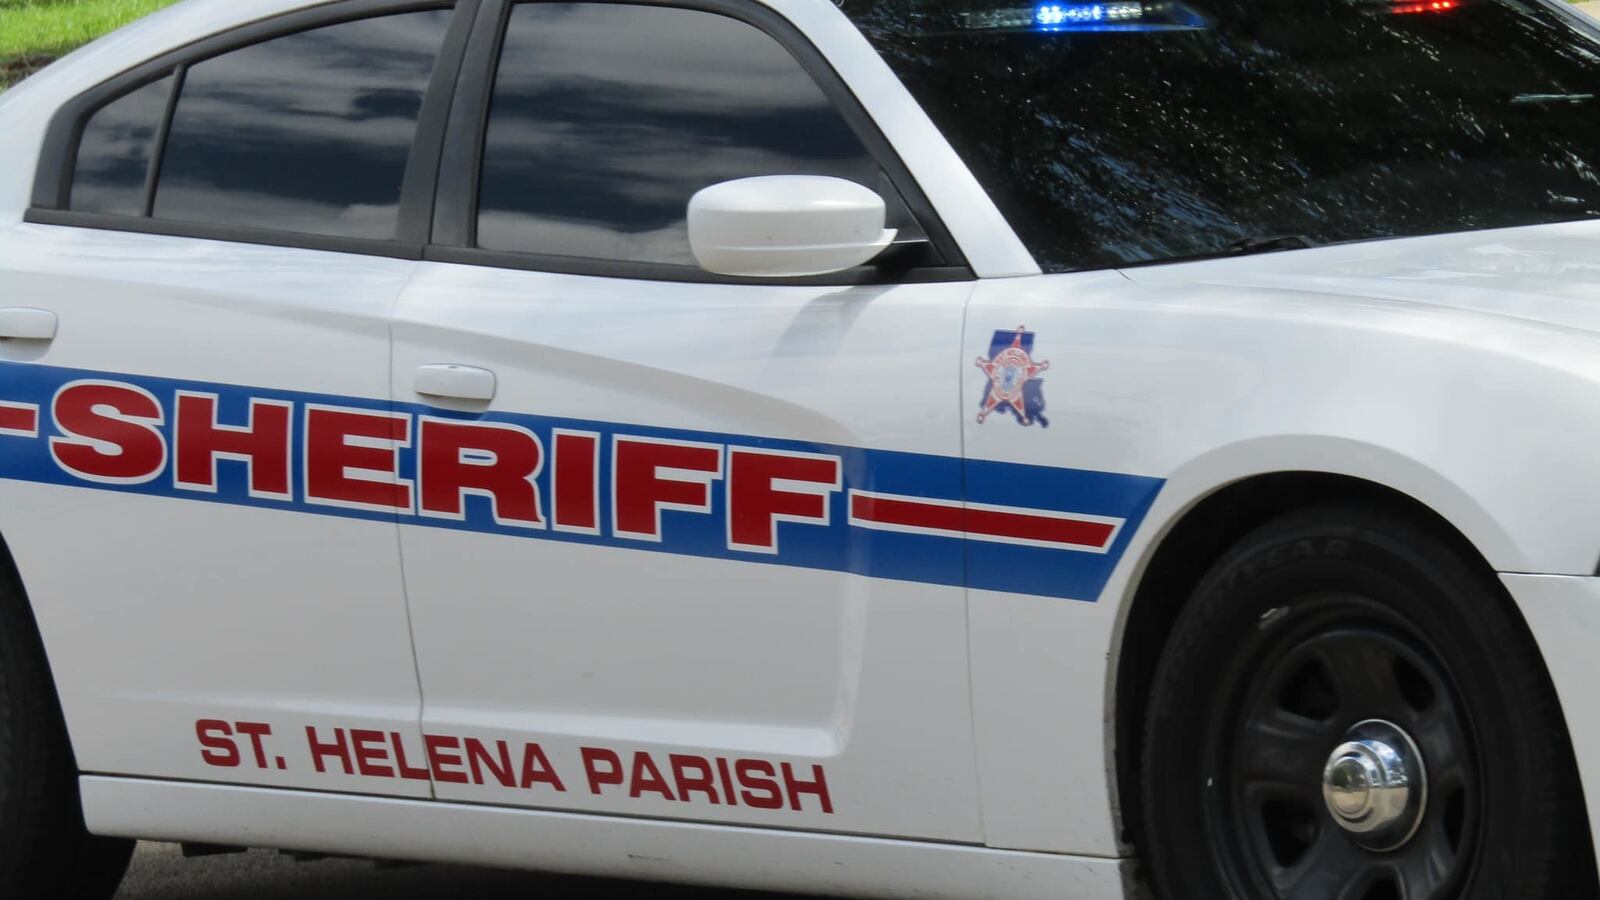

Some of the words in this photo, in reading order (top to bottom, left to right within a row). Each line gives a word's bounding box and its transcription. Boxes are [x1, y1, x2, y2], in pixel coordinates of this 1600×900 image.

[49, 379, 843, 556] SHERIFF
[196, 719, 286, 769] ST.
[306, 726, 565, 792] HELENA
[582, 747, 833, 814] PARISH
